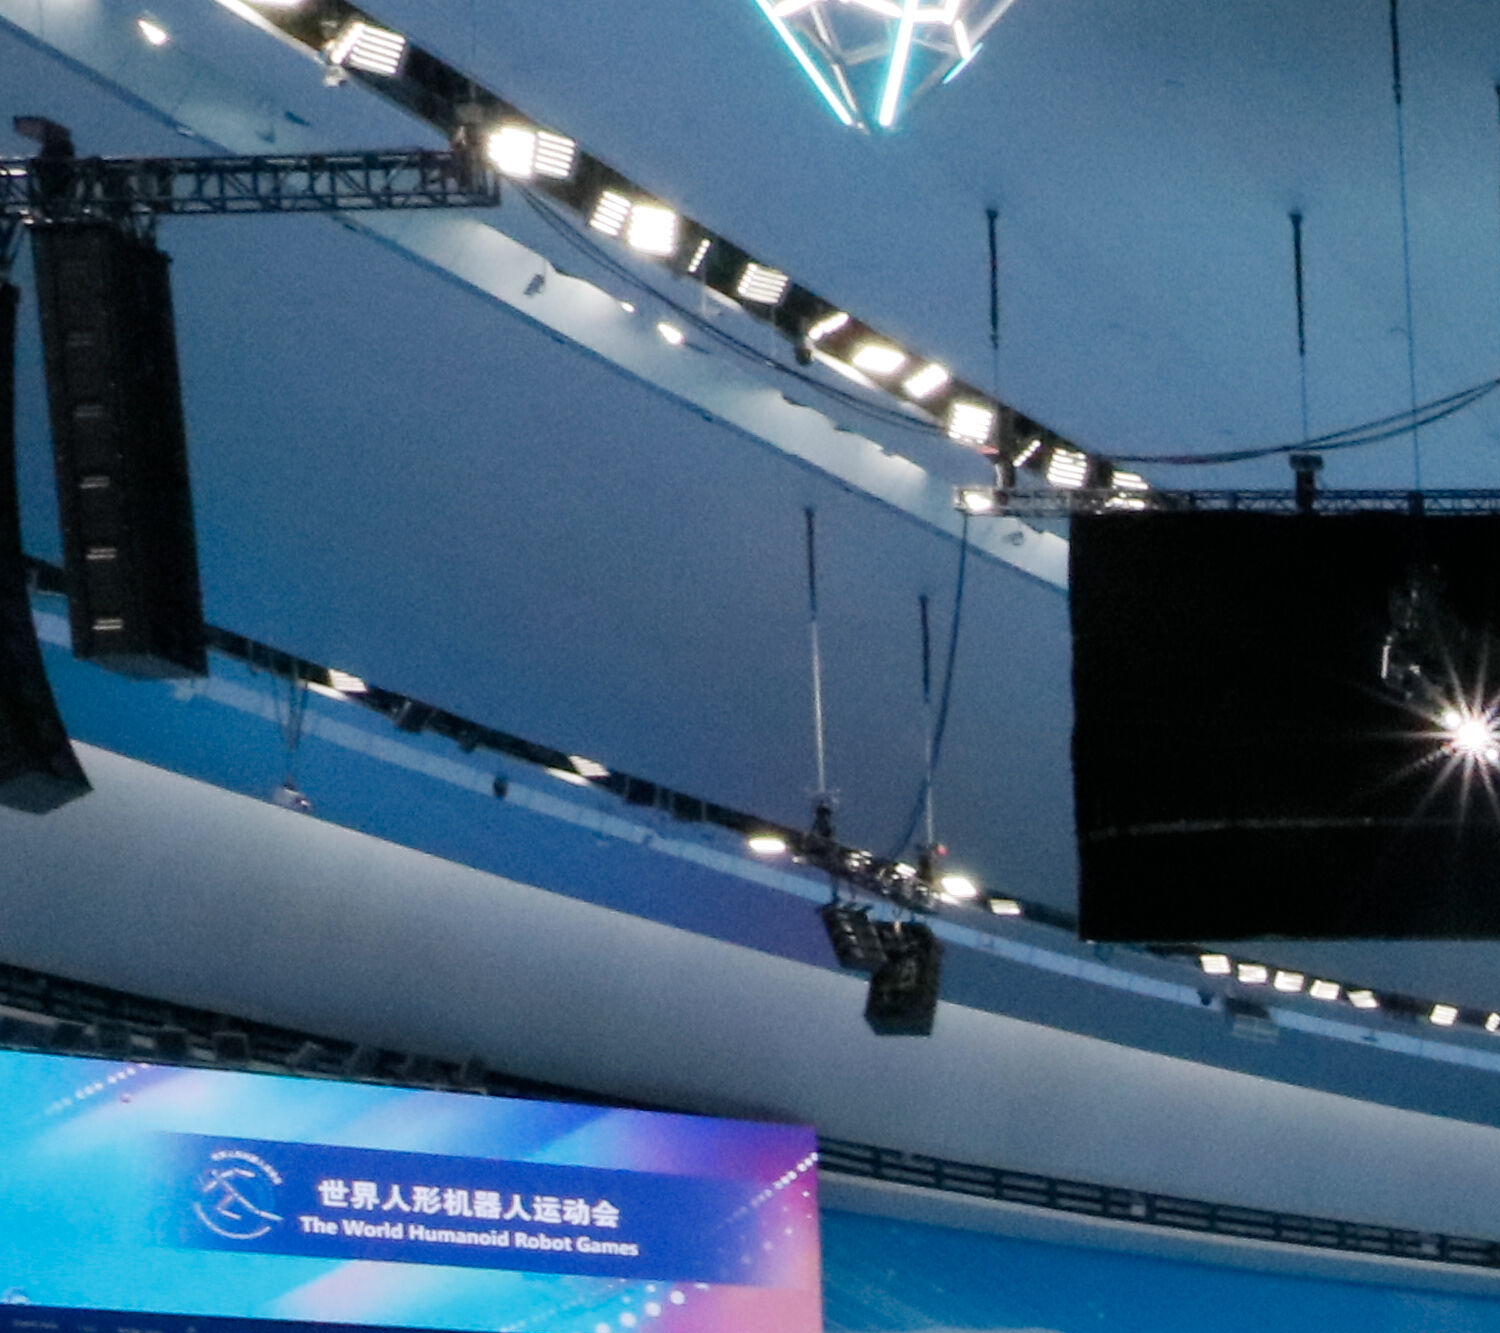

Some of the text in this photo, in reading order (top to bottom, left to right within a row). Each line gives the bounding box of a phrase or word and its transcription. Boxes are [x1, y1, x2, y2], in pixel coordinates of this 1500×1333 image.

[318, 1179, 620, 1229] 世界人形机器人运动会
[299, 1215, 639, 1256] The World Humanoid Robot Games
